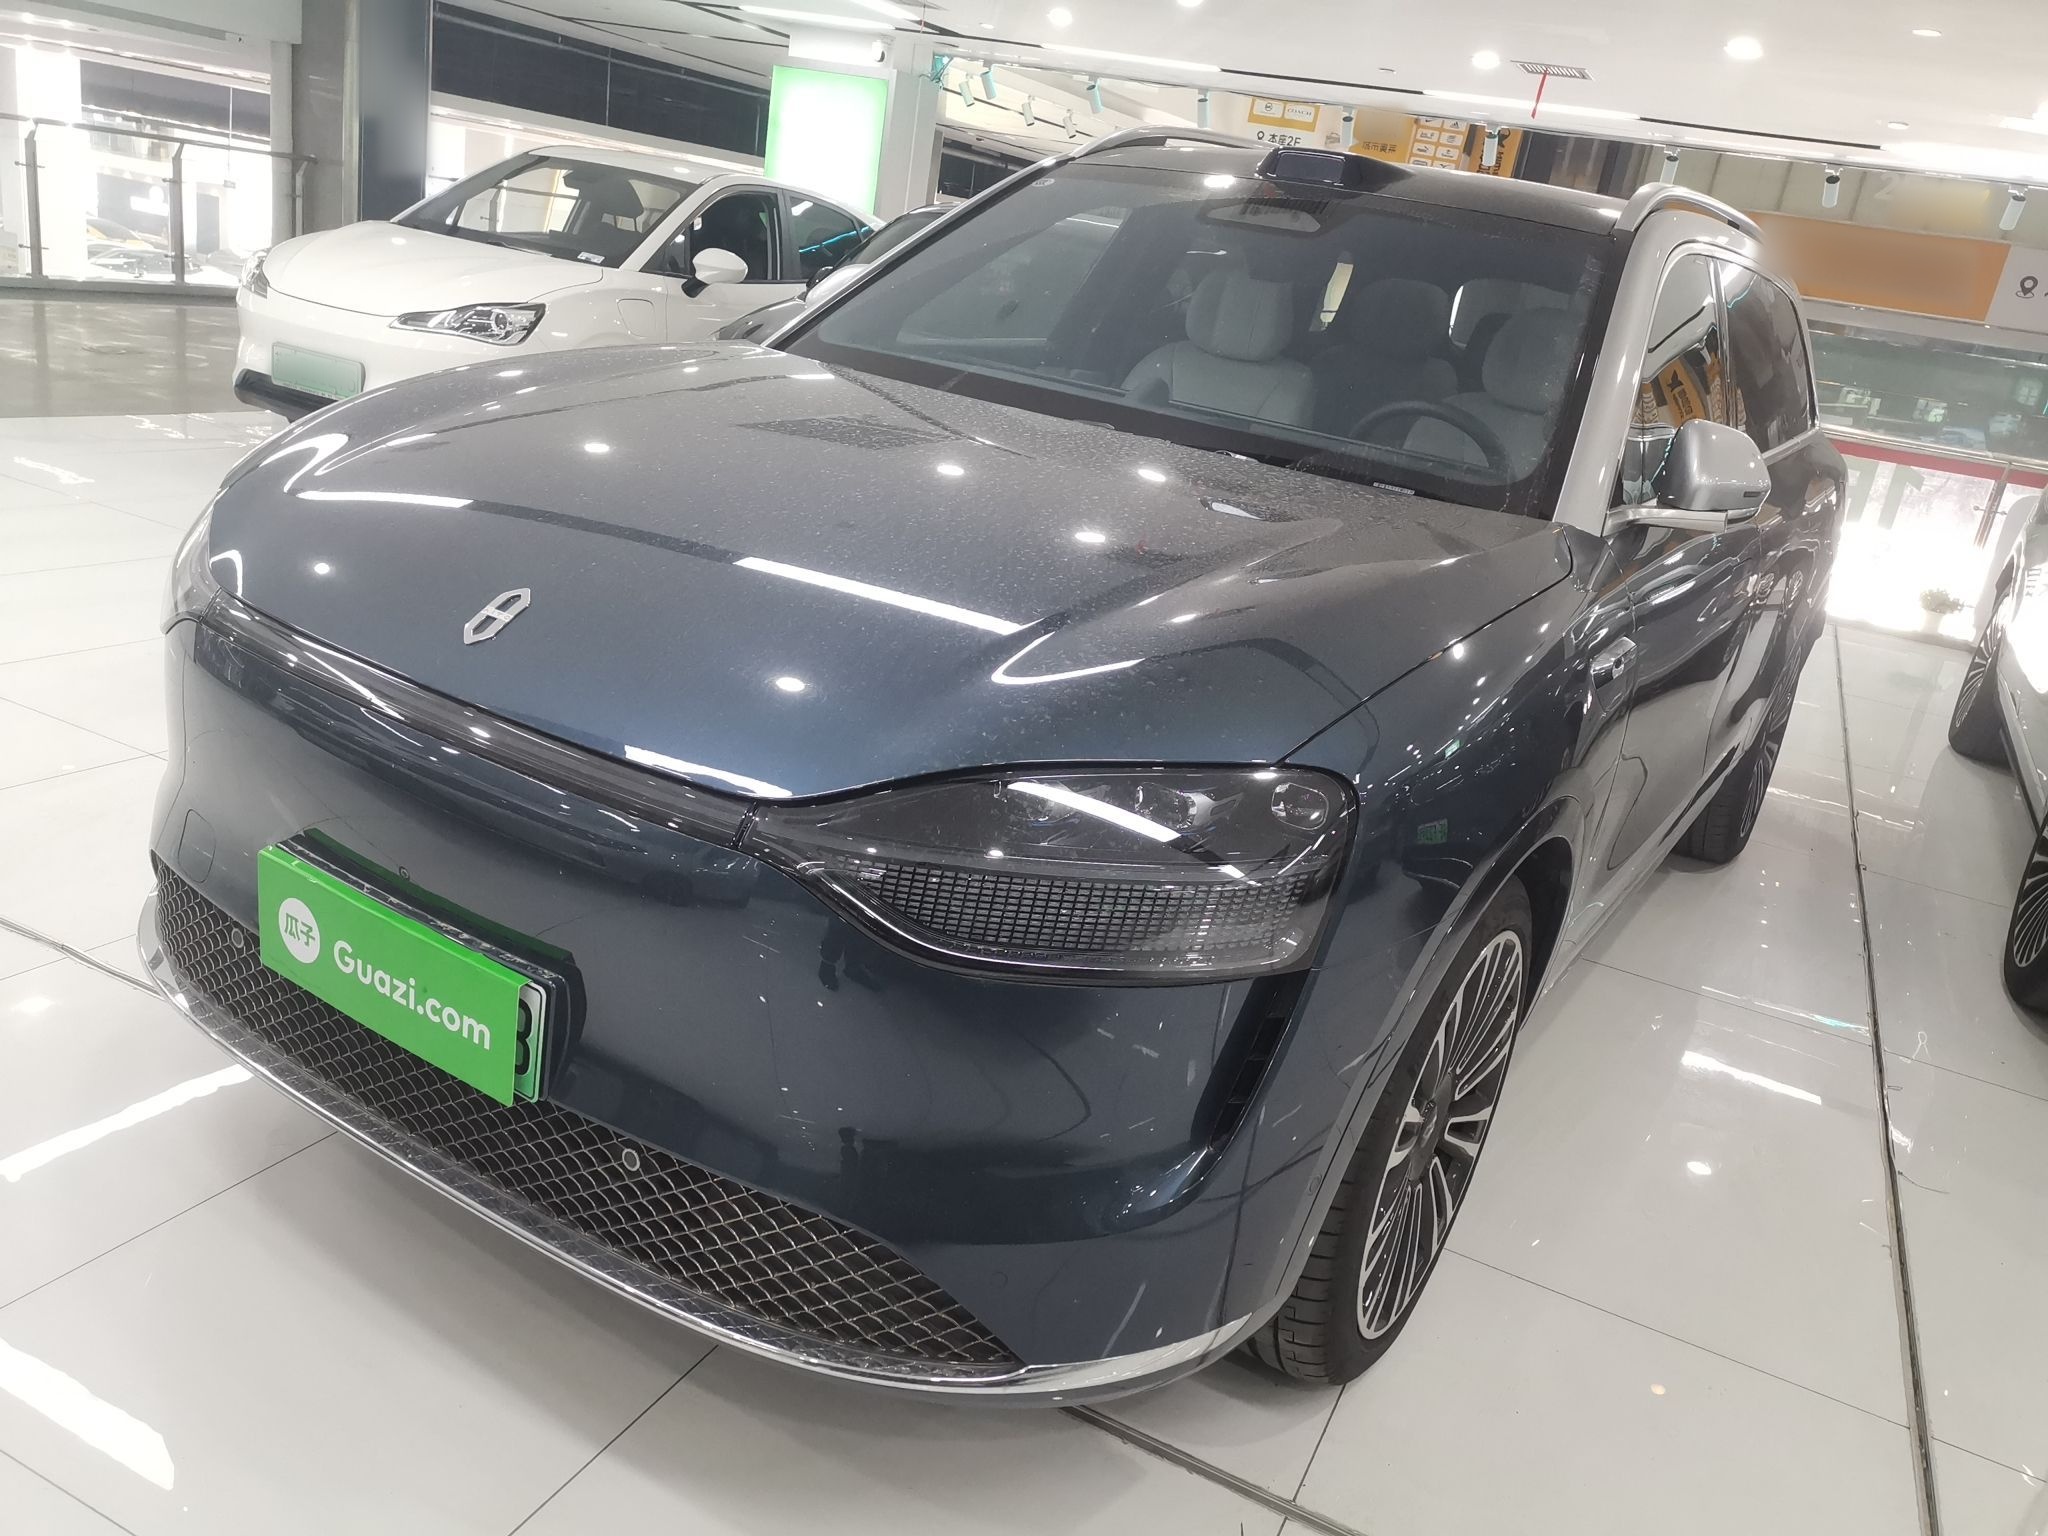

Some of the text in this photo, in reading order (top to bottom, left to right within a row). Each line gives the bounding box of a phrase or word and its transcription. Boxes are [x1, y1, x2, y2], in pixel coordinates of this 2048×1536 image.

[1268, 134, 1301, 146] 本座2F
[284, 912, 315, 947] 瓜子
[333, 940, 490, 1051] Guazi.com
